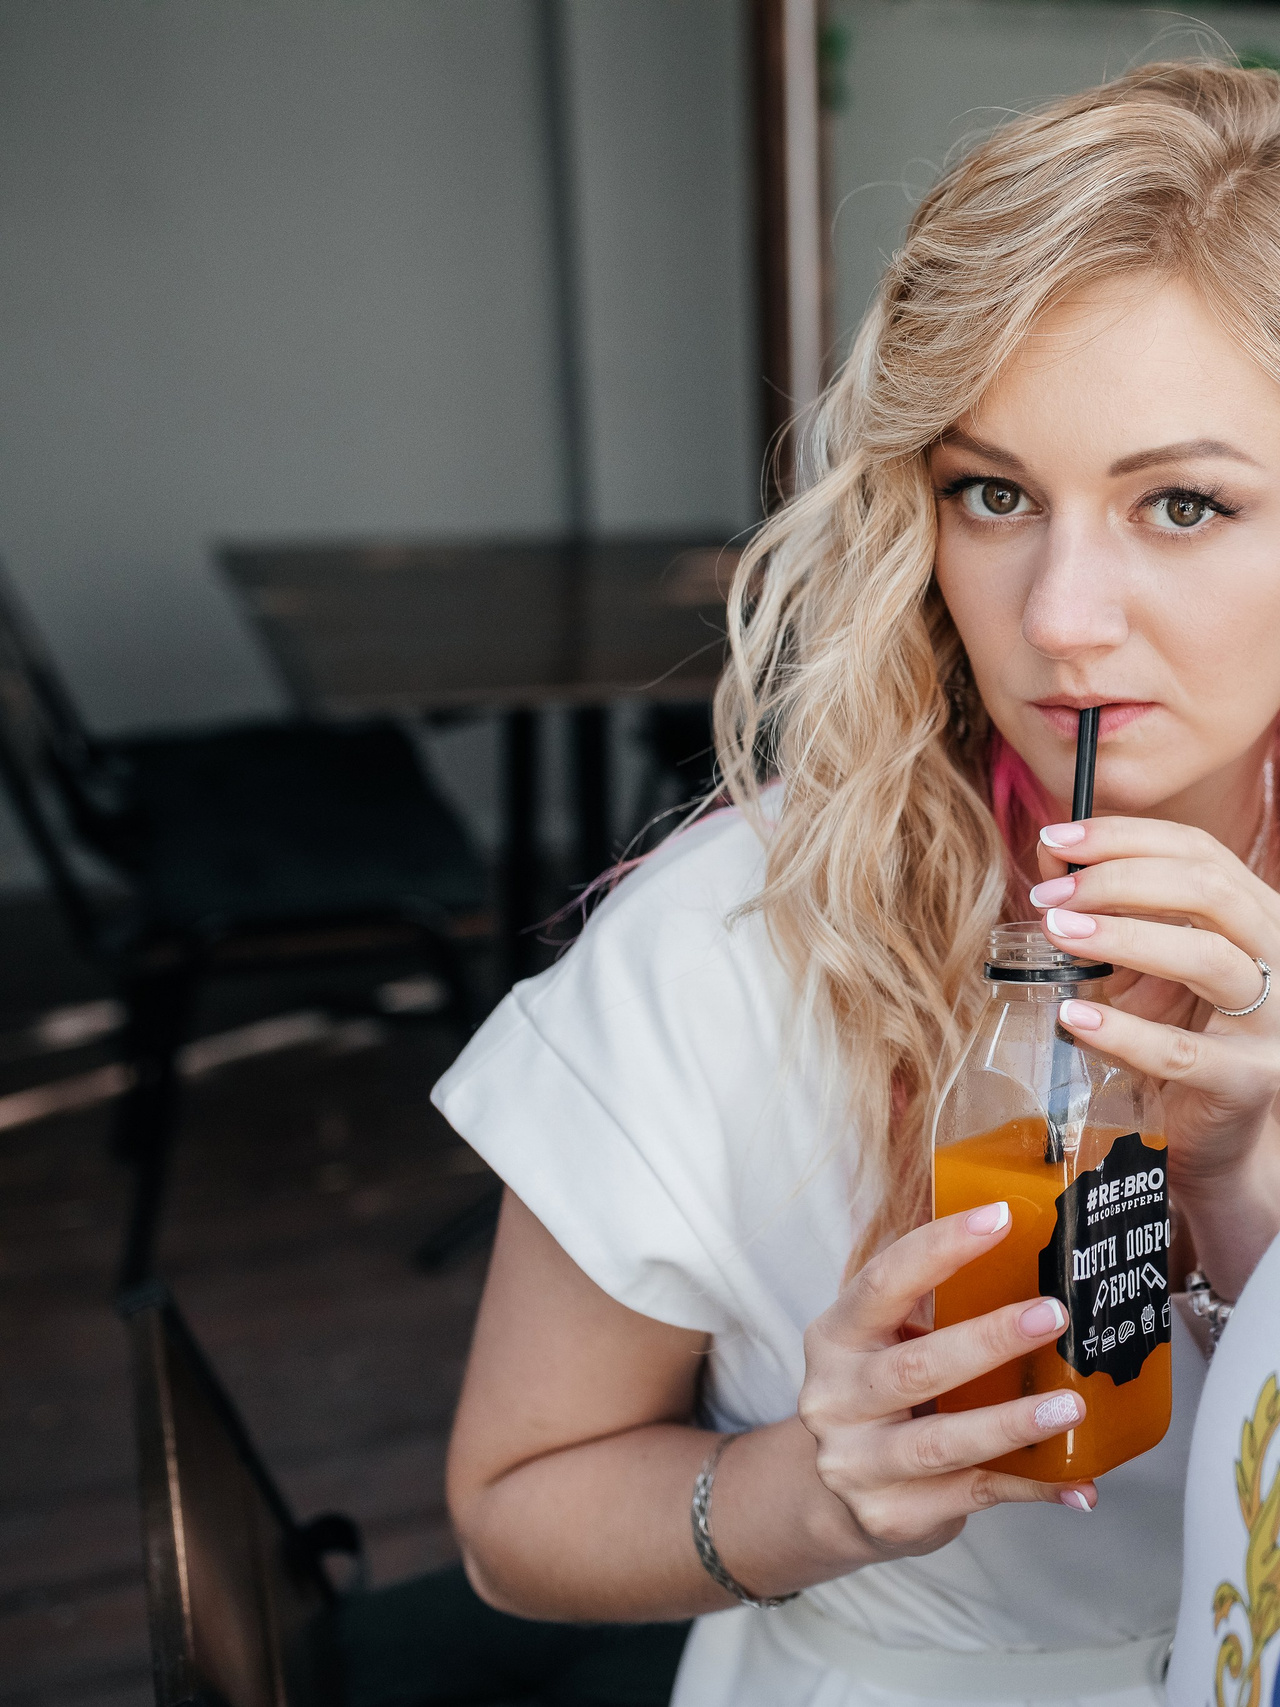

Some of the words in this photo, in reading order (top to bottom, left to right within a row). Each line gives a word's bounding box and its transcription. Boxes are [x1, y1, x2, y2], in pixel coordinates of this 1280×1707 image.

[1086, 1167, 1165, 1212] #RE:BRO
[1072, 1235, 1117, 1281] МУТИ
[1126, 1218, 1171, 1261] ДОБРО
[1109, 1266, 1141, 1308] БРО!
